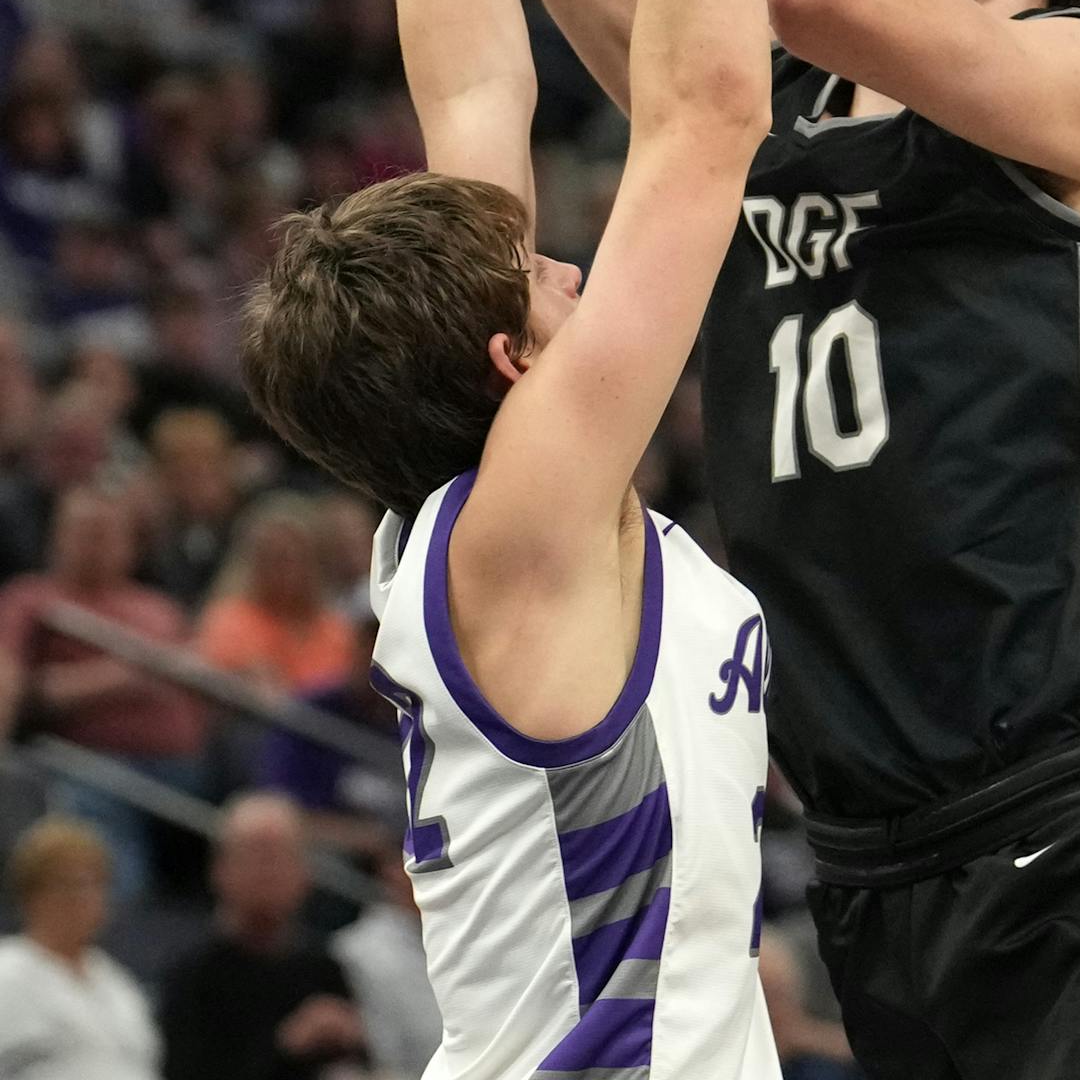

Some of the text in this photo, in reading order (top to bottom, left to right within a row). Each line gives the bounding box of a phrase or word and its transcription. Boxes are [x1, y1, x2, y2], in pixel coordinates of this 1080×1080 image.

[742, 189, 883, 290] DGF
[769, 299, 891, 484] 10
[708, 613, 772, 716] A
